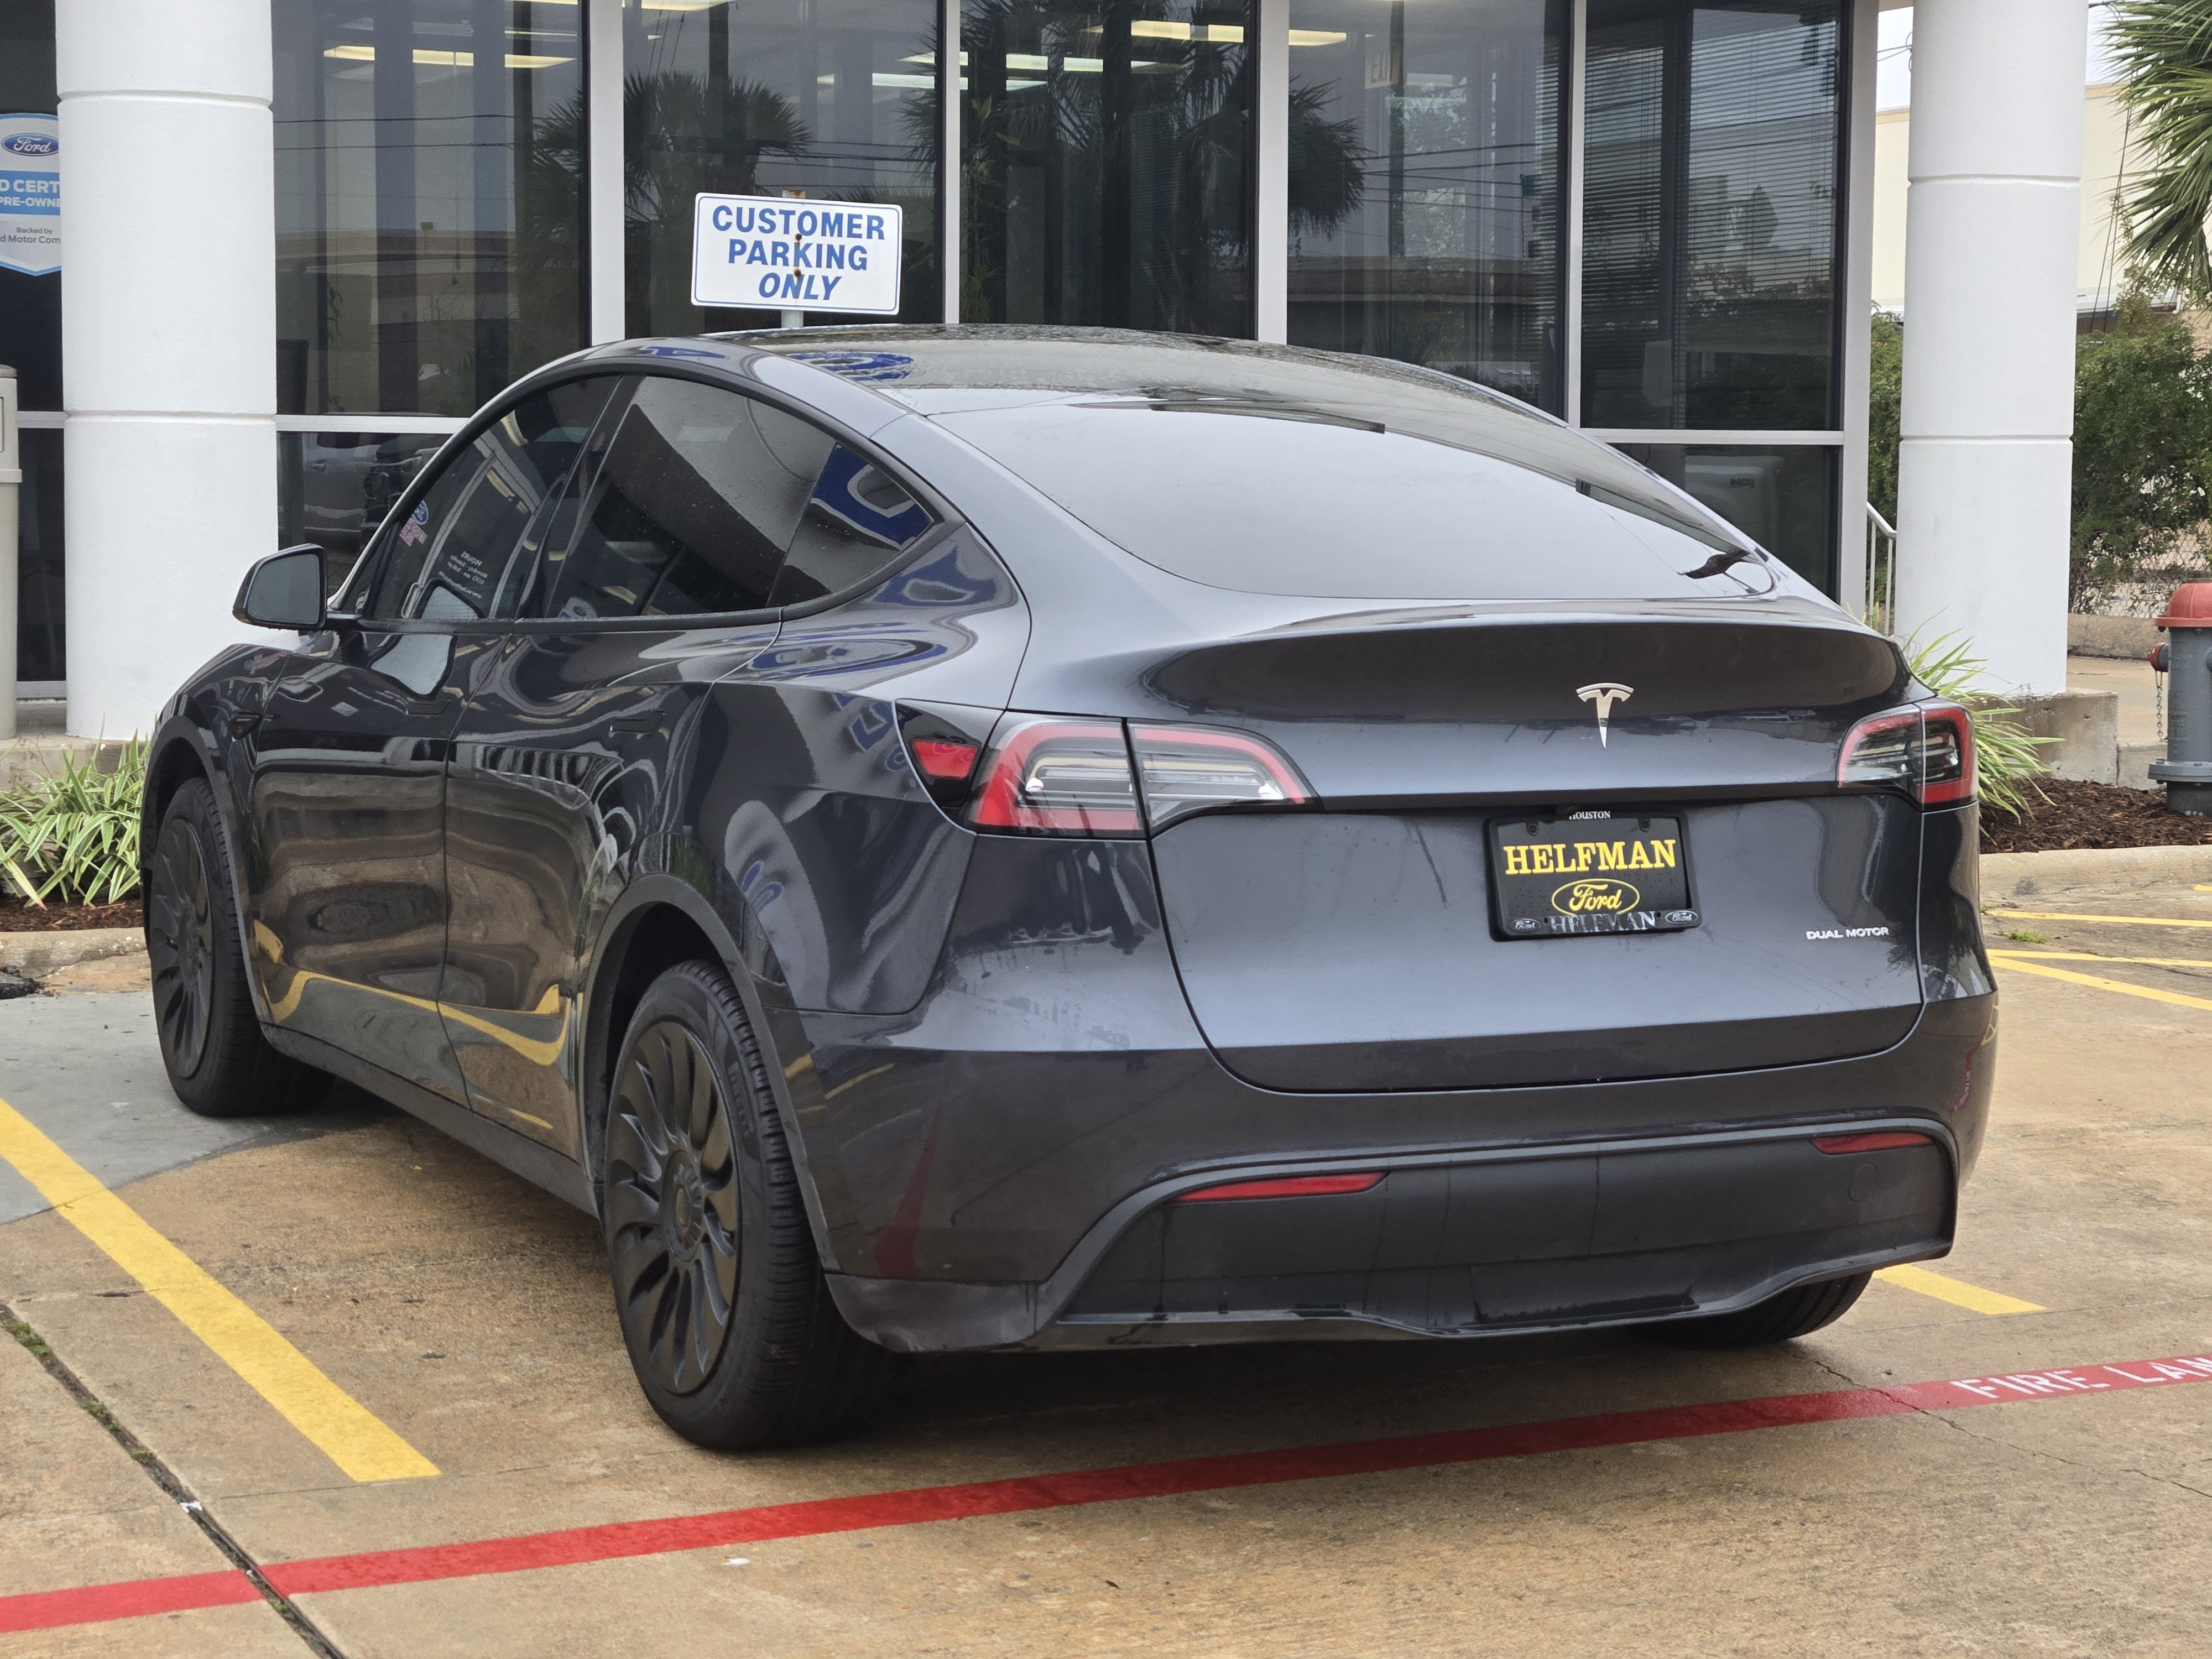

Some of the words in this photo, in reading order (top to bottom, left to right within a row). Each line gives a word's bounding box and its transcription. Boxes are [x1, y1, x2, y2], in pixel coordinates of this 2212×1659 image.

[13, 136, 51, 153] Ford
[712, 205, 885, 240] CUSTOMER
[8, 234, 37, 243] Motor
[38, 236, 61, 244] Com
[728, 238, 868, 271] PARKING
[758, 272, 843, 300] ONLY
[1503, 839, 1676, 875] HELFMAN
[1569, 884, 1622, 911] Ford
[1672, 912, 1692, 922] Ford
[1806, 930, 1844, 940] DUAL
[1845, 926, 1890, 938] MOTOR
[1949, 1370, 2111, 1399] FIRE
